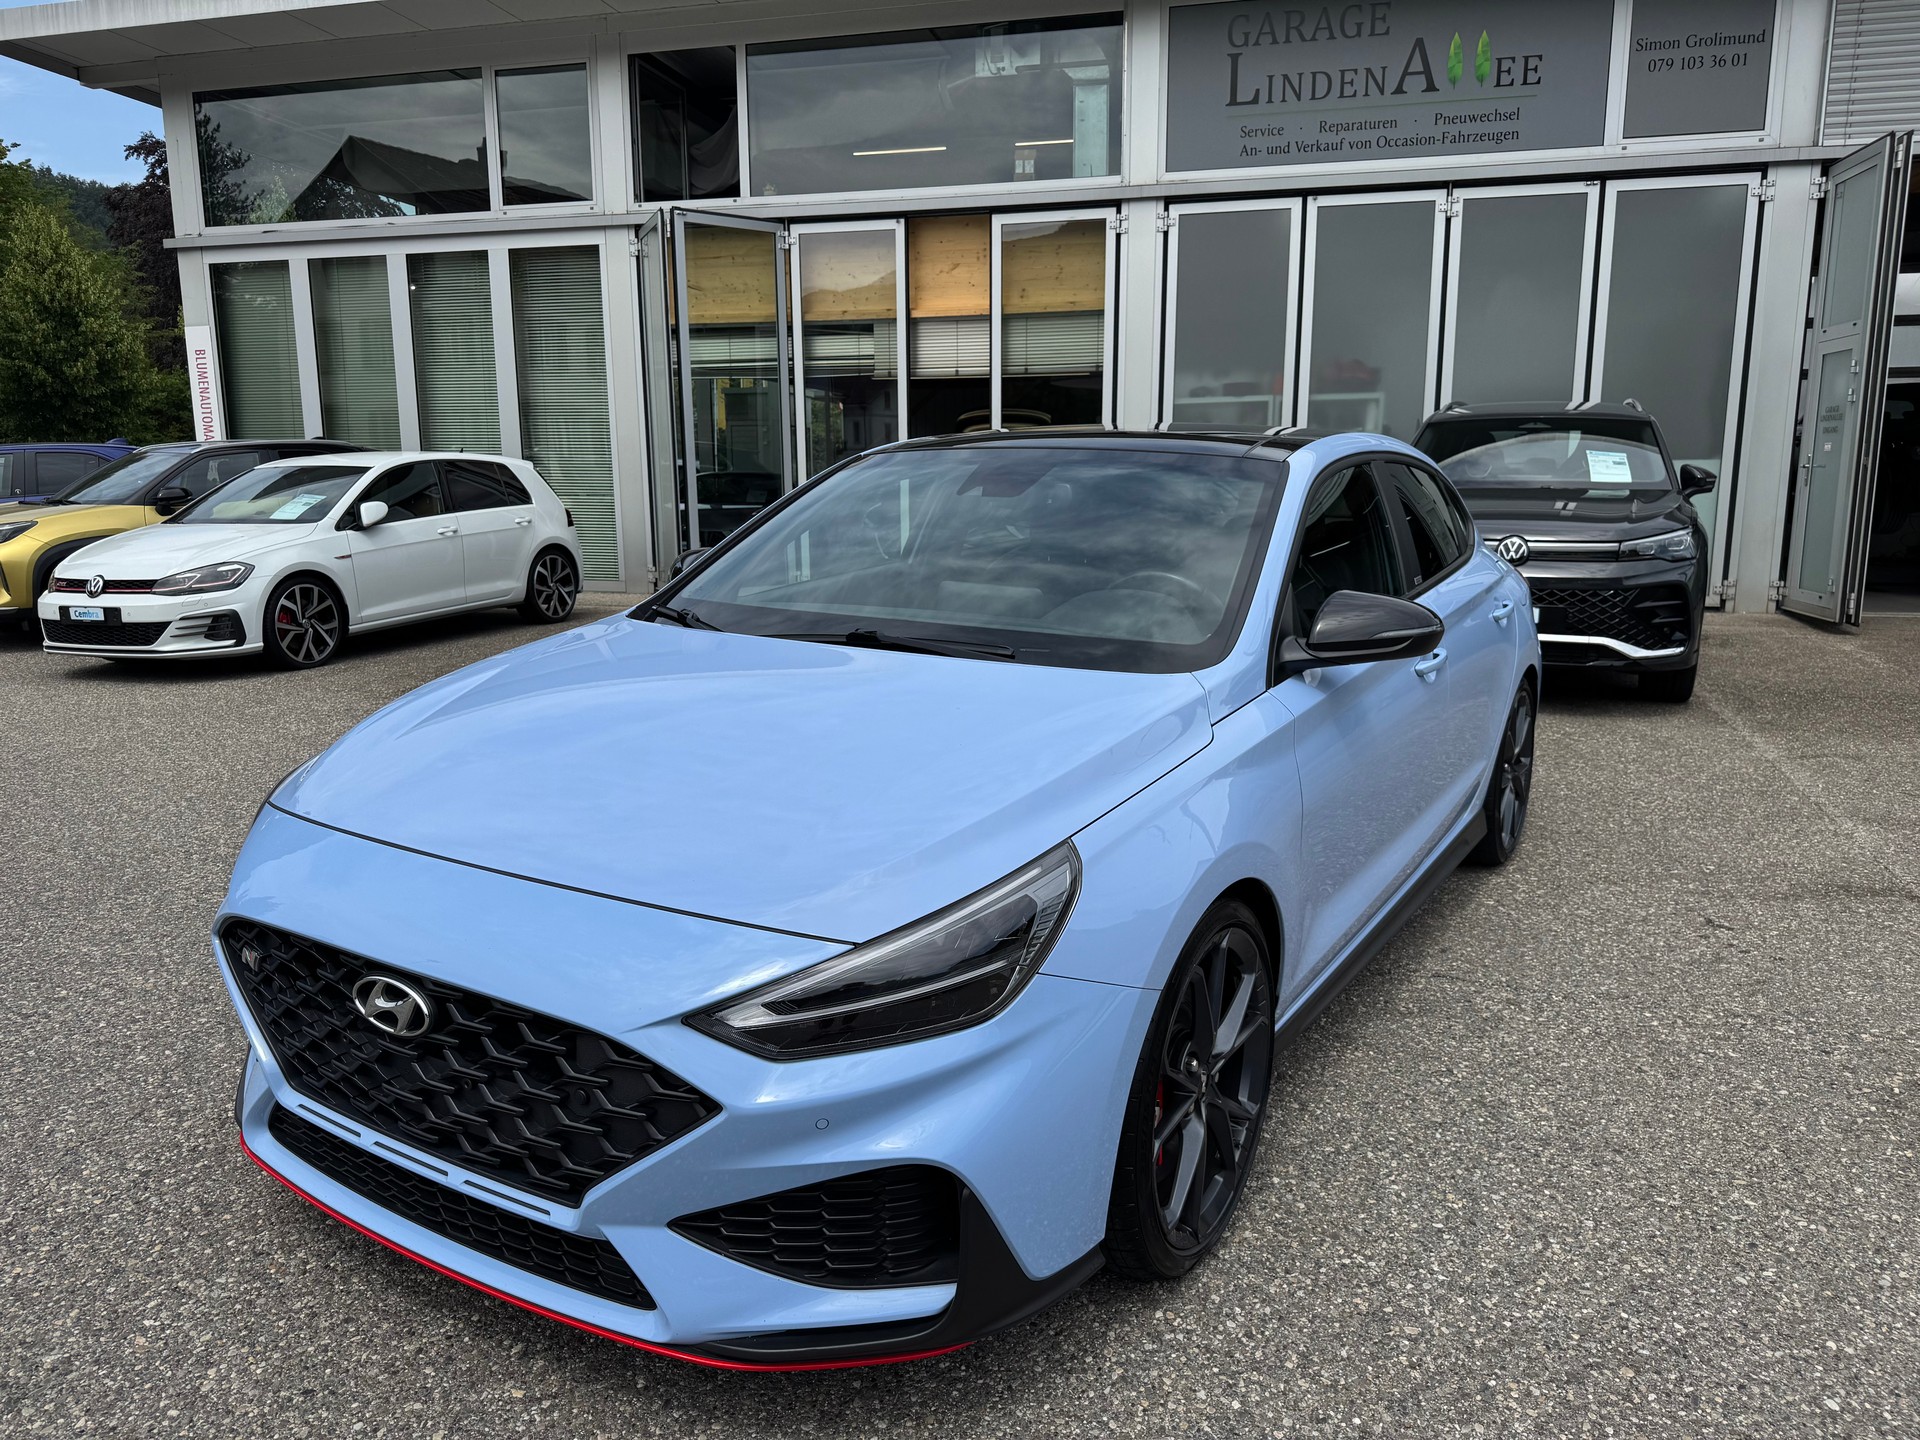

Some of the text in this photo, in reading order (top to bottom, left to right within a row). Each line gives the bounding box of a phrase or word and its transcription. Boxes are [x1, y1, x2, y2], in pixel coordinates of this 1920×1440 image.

[1227, 1, 1392, 48] GARAGE
[1635, 29, 1766, 52] Simon Grolimund
[1647, 52, 1748, 72] 079 103 36 01
[1239, 107, 1521, 139] Service Reparaturen Pneuwechsel
[1239, 128, 1520, 157] An- und Verkauf von Occasion-Fahrzeugen
[194, 349, 215, 441] BLUMENAUTOMA
[74, 609, 100, 619] Cembra
